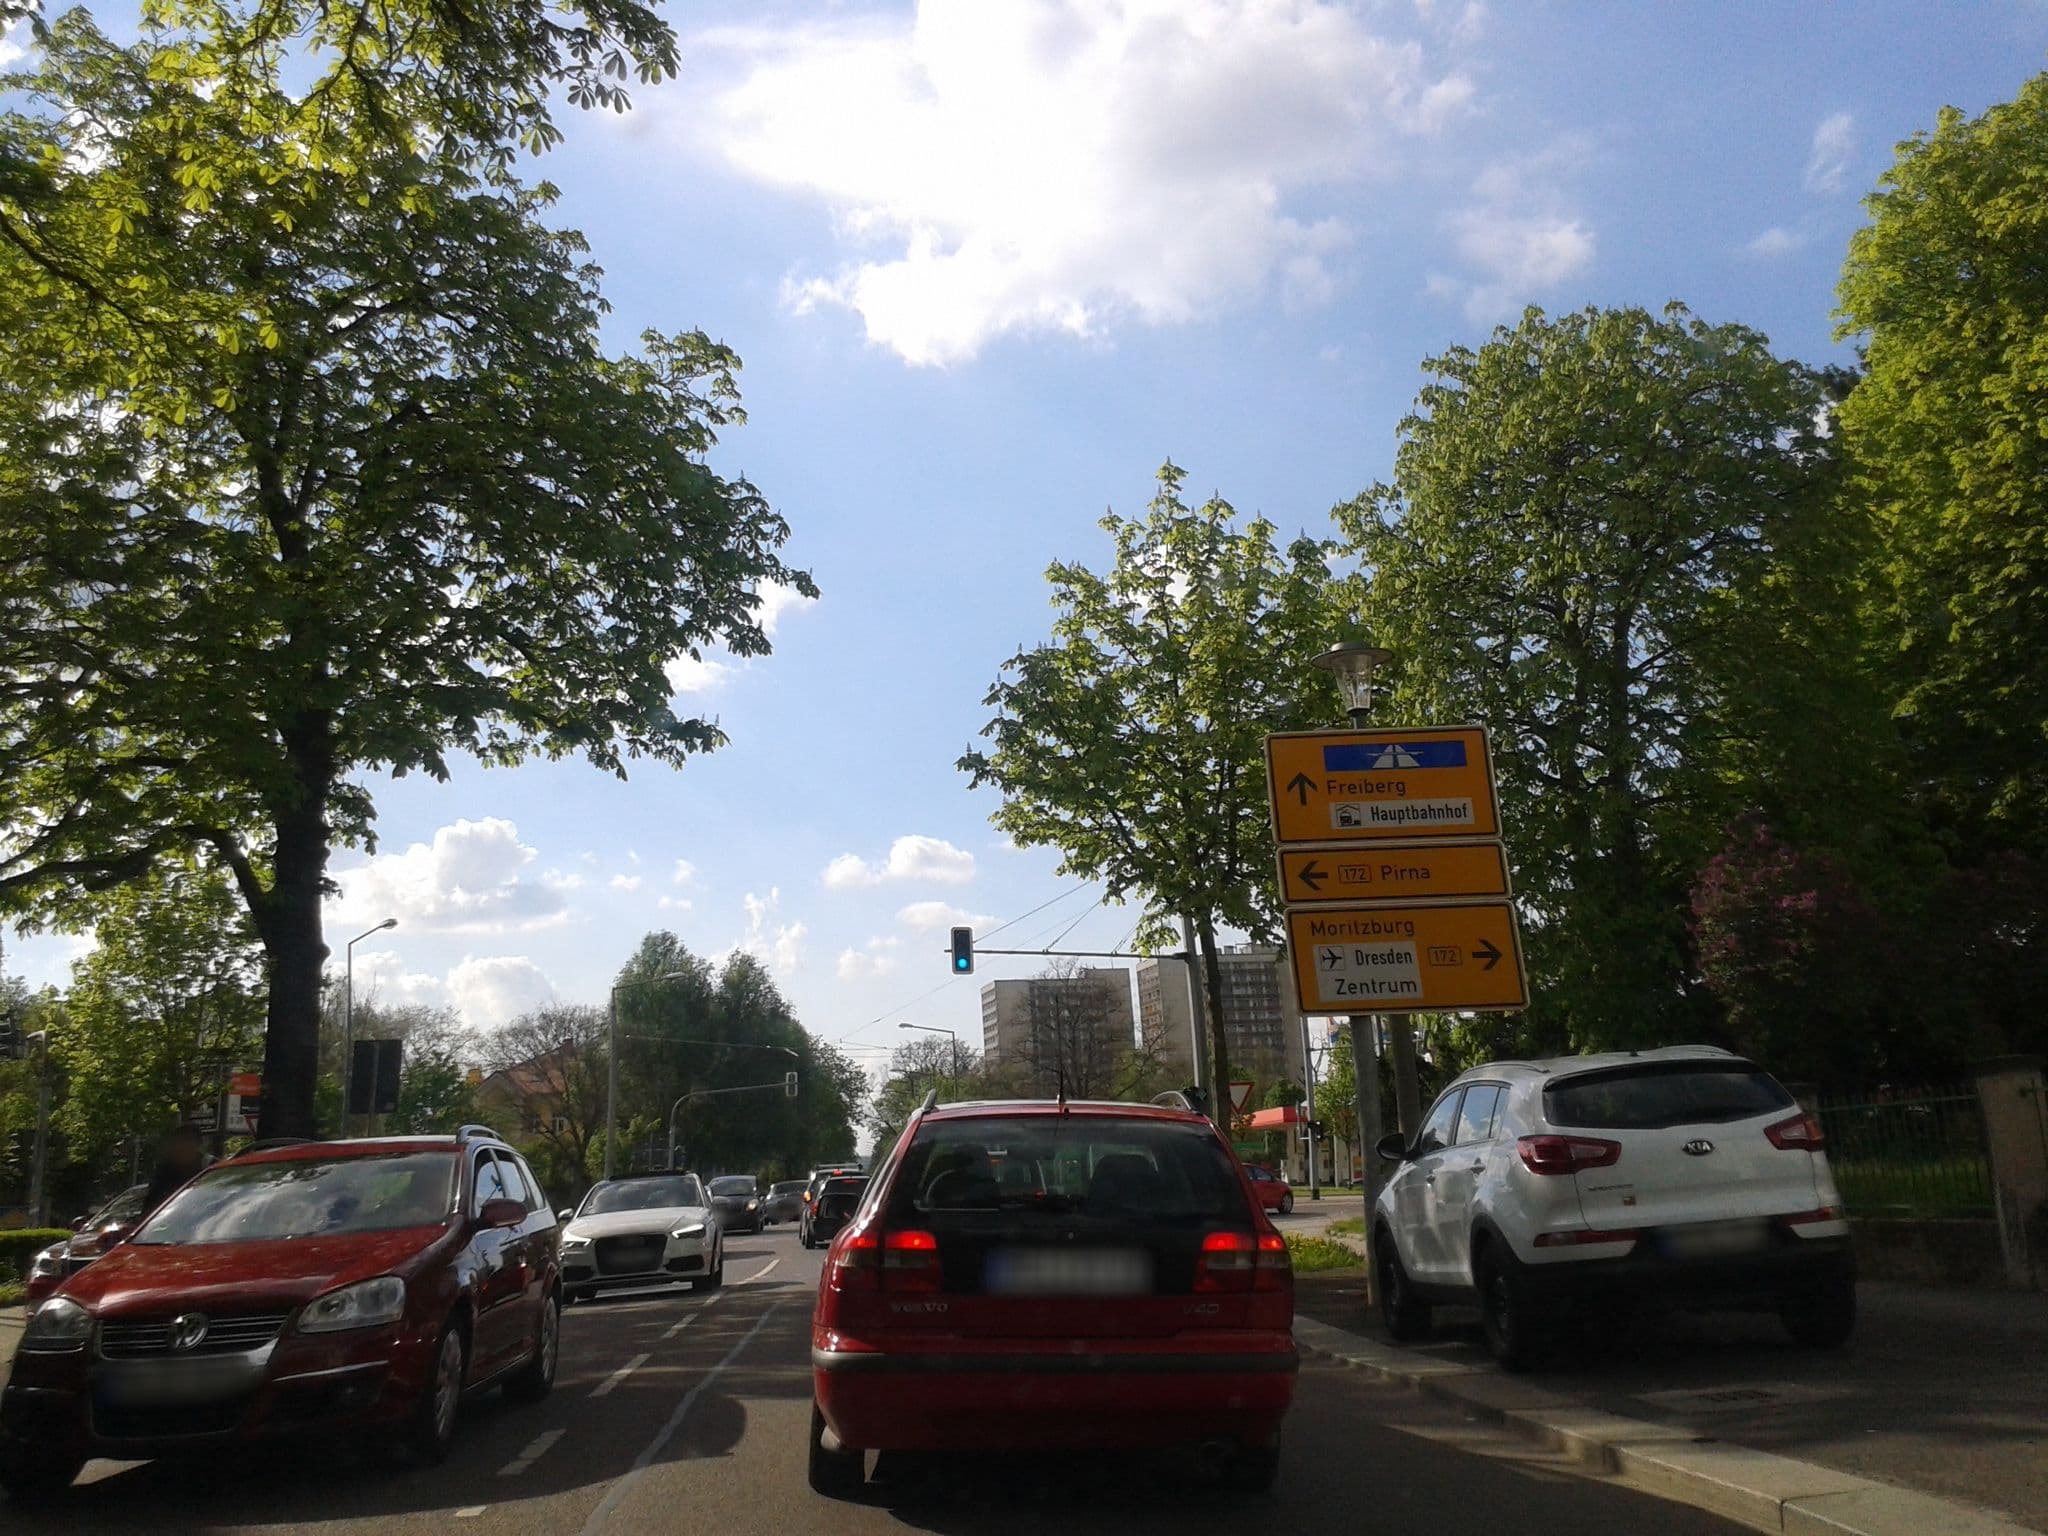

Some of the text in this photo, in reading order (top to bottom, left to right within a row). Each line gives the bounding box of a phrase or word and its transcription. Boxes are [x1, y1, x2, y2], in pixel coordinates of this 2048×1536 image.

[1327, 779, 1407, 796] Freiberg
[1371, 803, 1468, 824] Hauptbahnhof
[1342, 864, 1431, 881] 172 Pirna
[1311, 919, 1415, 937] Moritzburg
[1356, 949, 1413, 966] Dresden
[1433, 950, 1457, 963] 172
[1335, 978, 1418, 995] Zentrum
[1686, 1141, 1711, 1152] KIA
